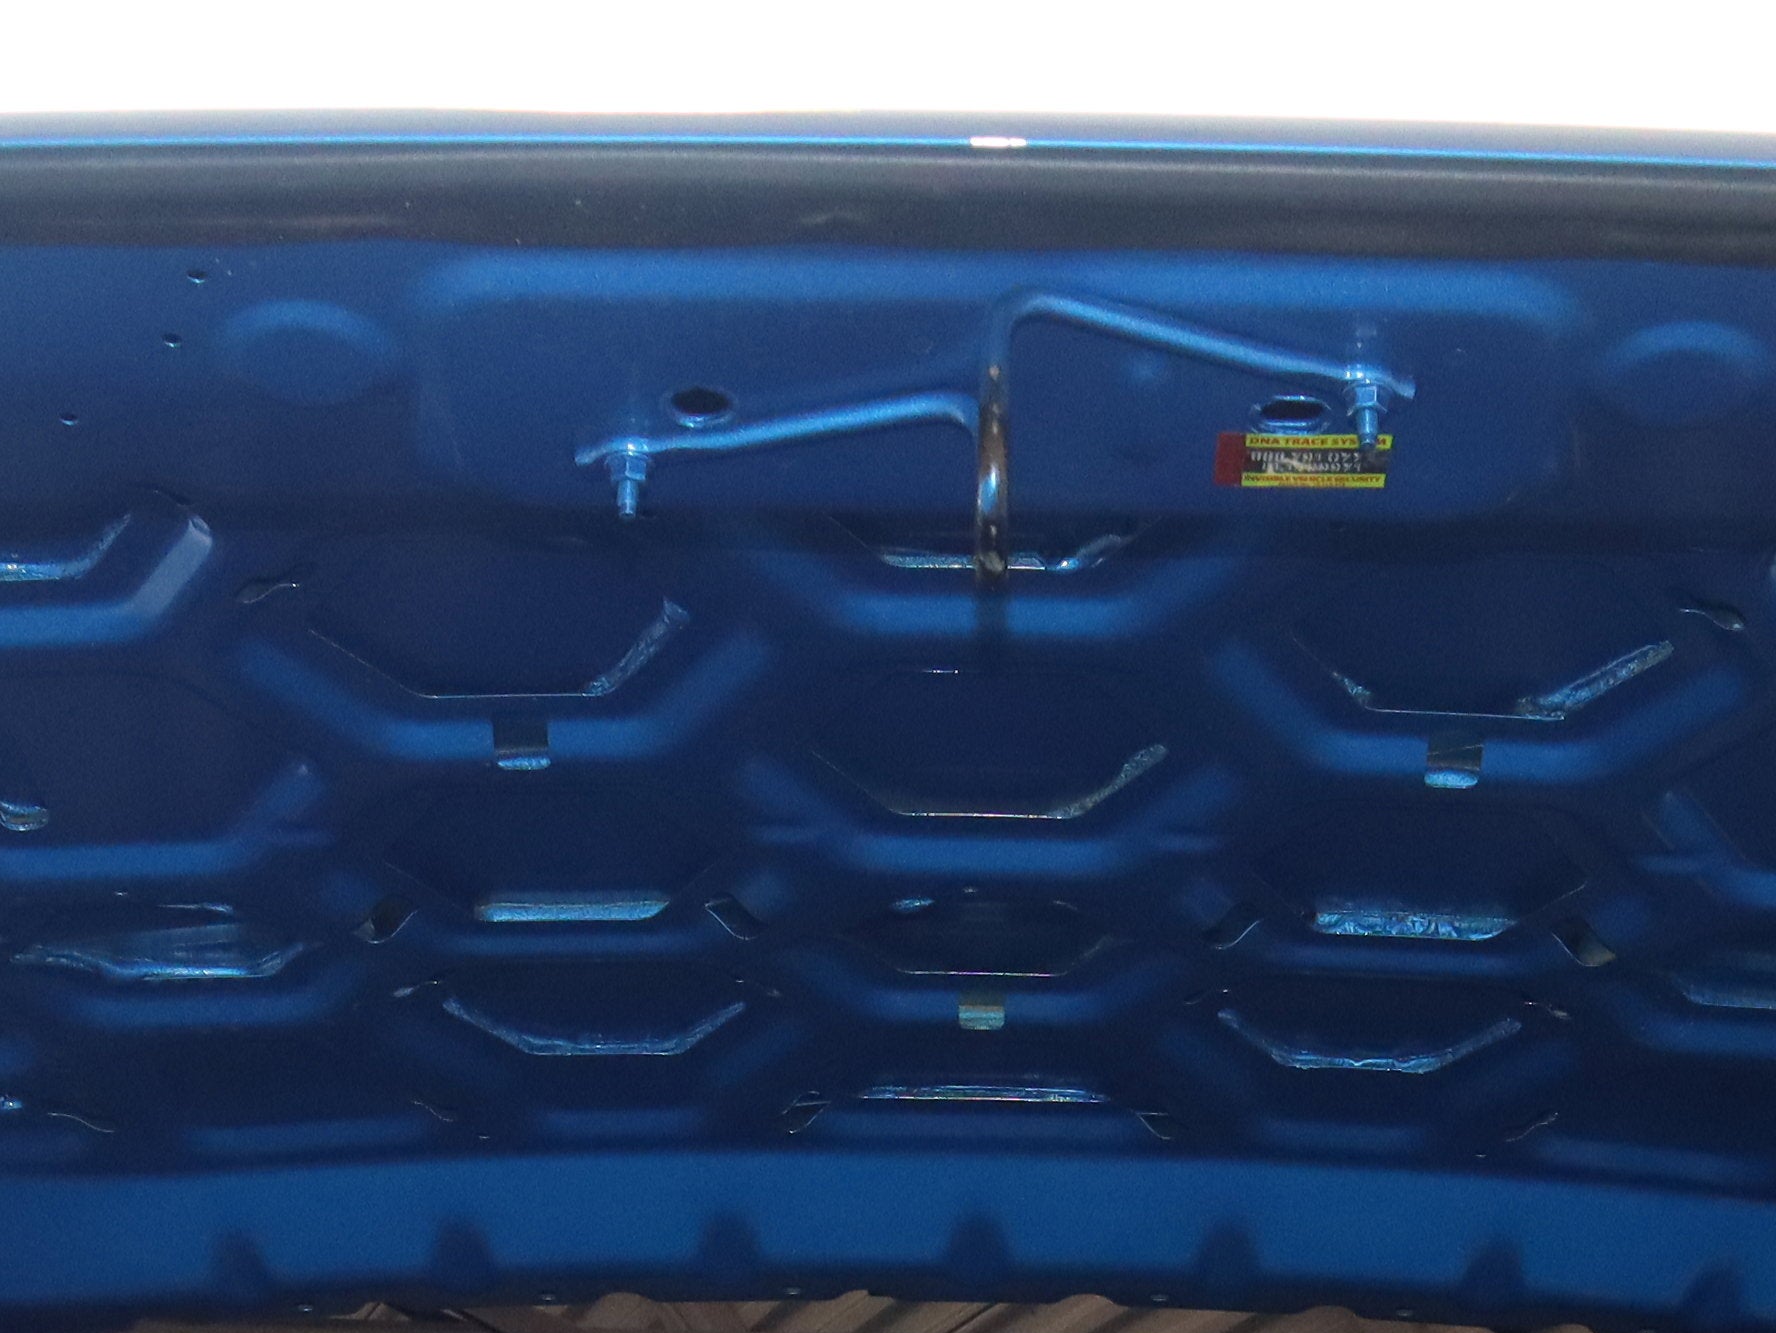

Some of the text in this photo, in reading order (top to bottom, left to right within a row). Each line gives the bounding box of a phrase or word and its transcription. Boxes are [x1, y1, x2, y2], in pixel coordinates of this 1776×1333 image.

[1250, 437, 1387, 446] DNA TRACE SYSM
